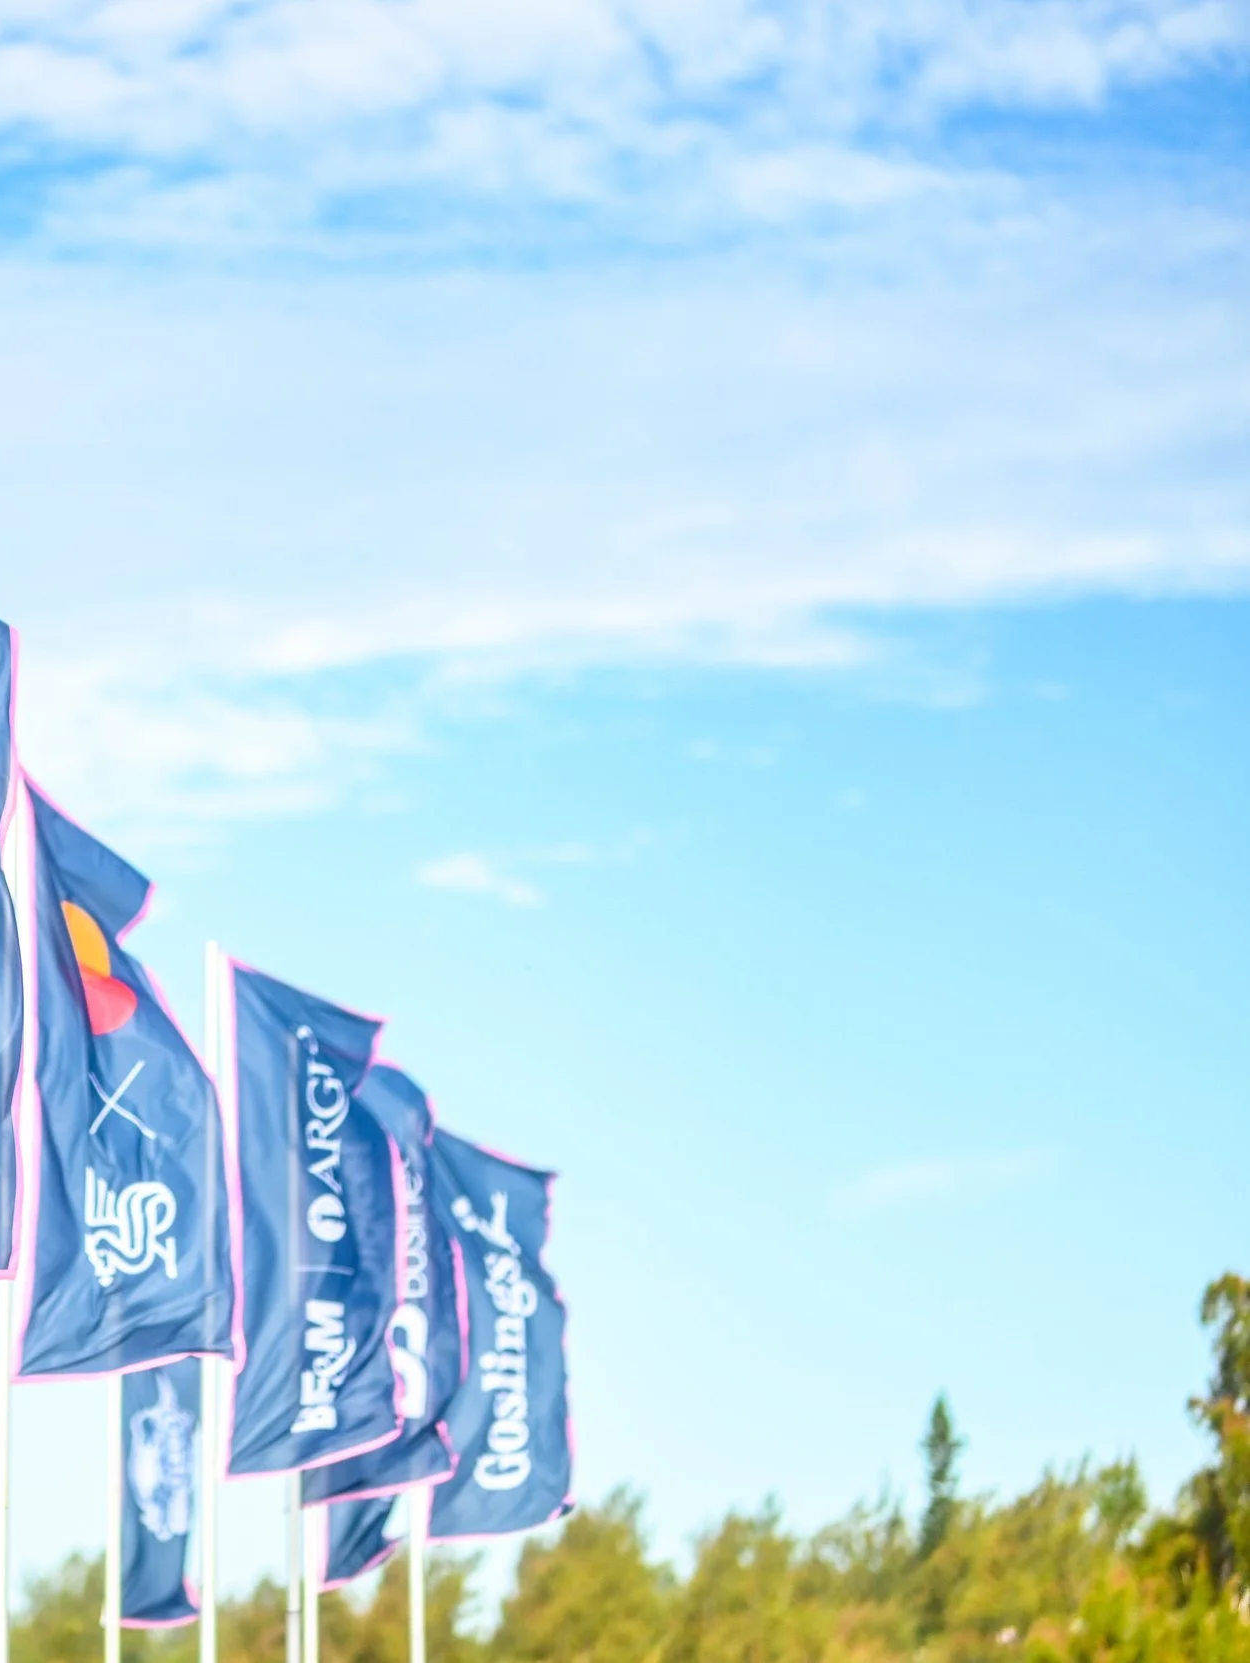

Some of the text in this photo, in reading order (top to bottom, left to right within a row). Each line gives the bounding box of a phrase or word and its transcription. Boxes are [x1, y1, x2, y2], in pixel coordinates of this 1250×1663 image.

[290, 1025, 357, 1434] BF&M ARG
[473, 1252, 538, 1490] Goslings
